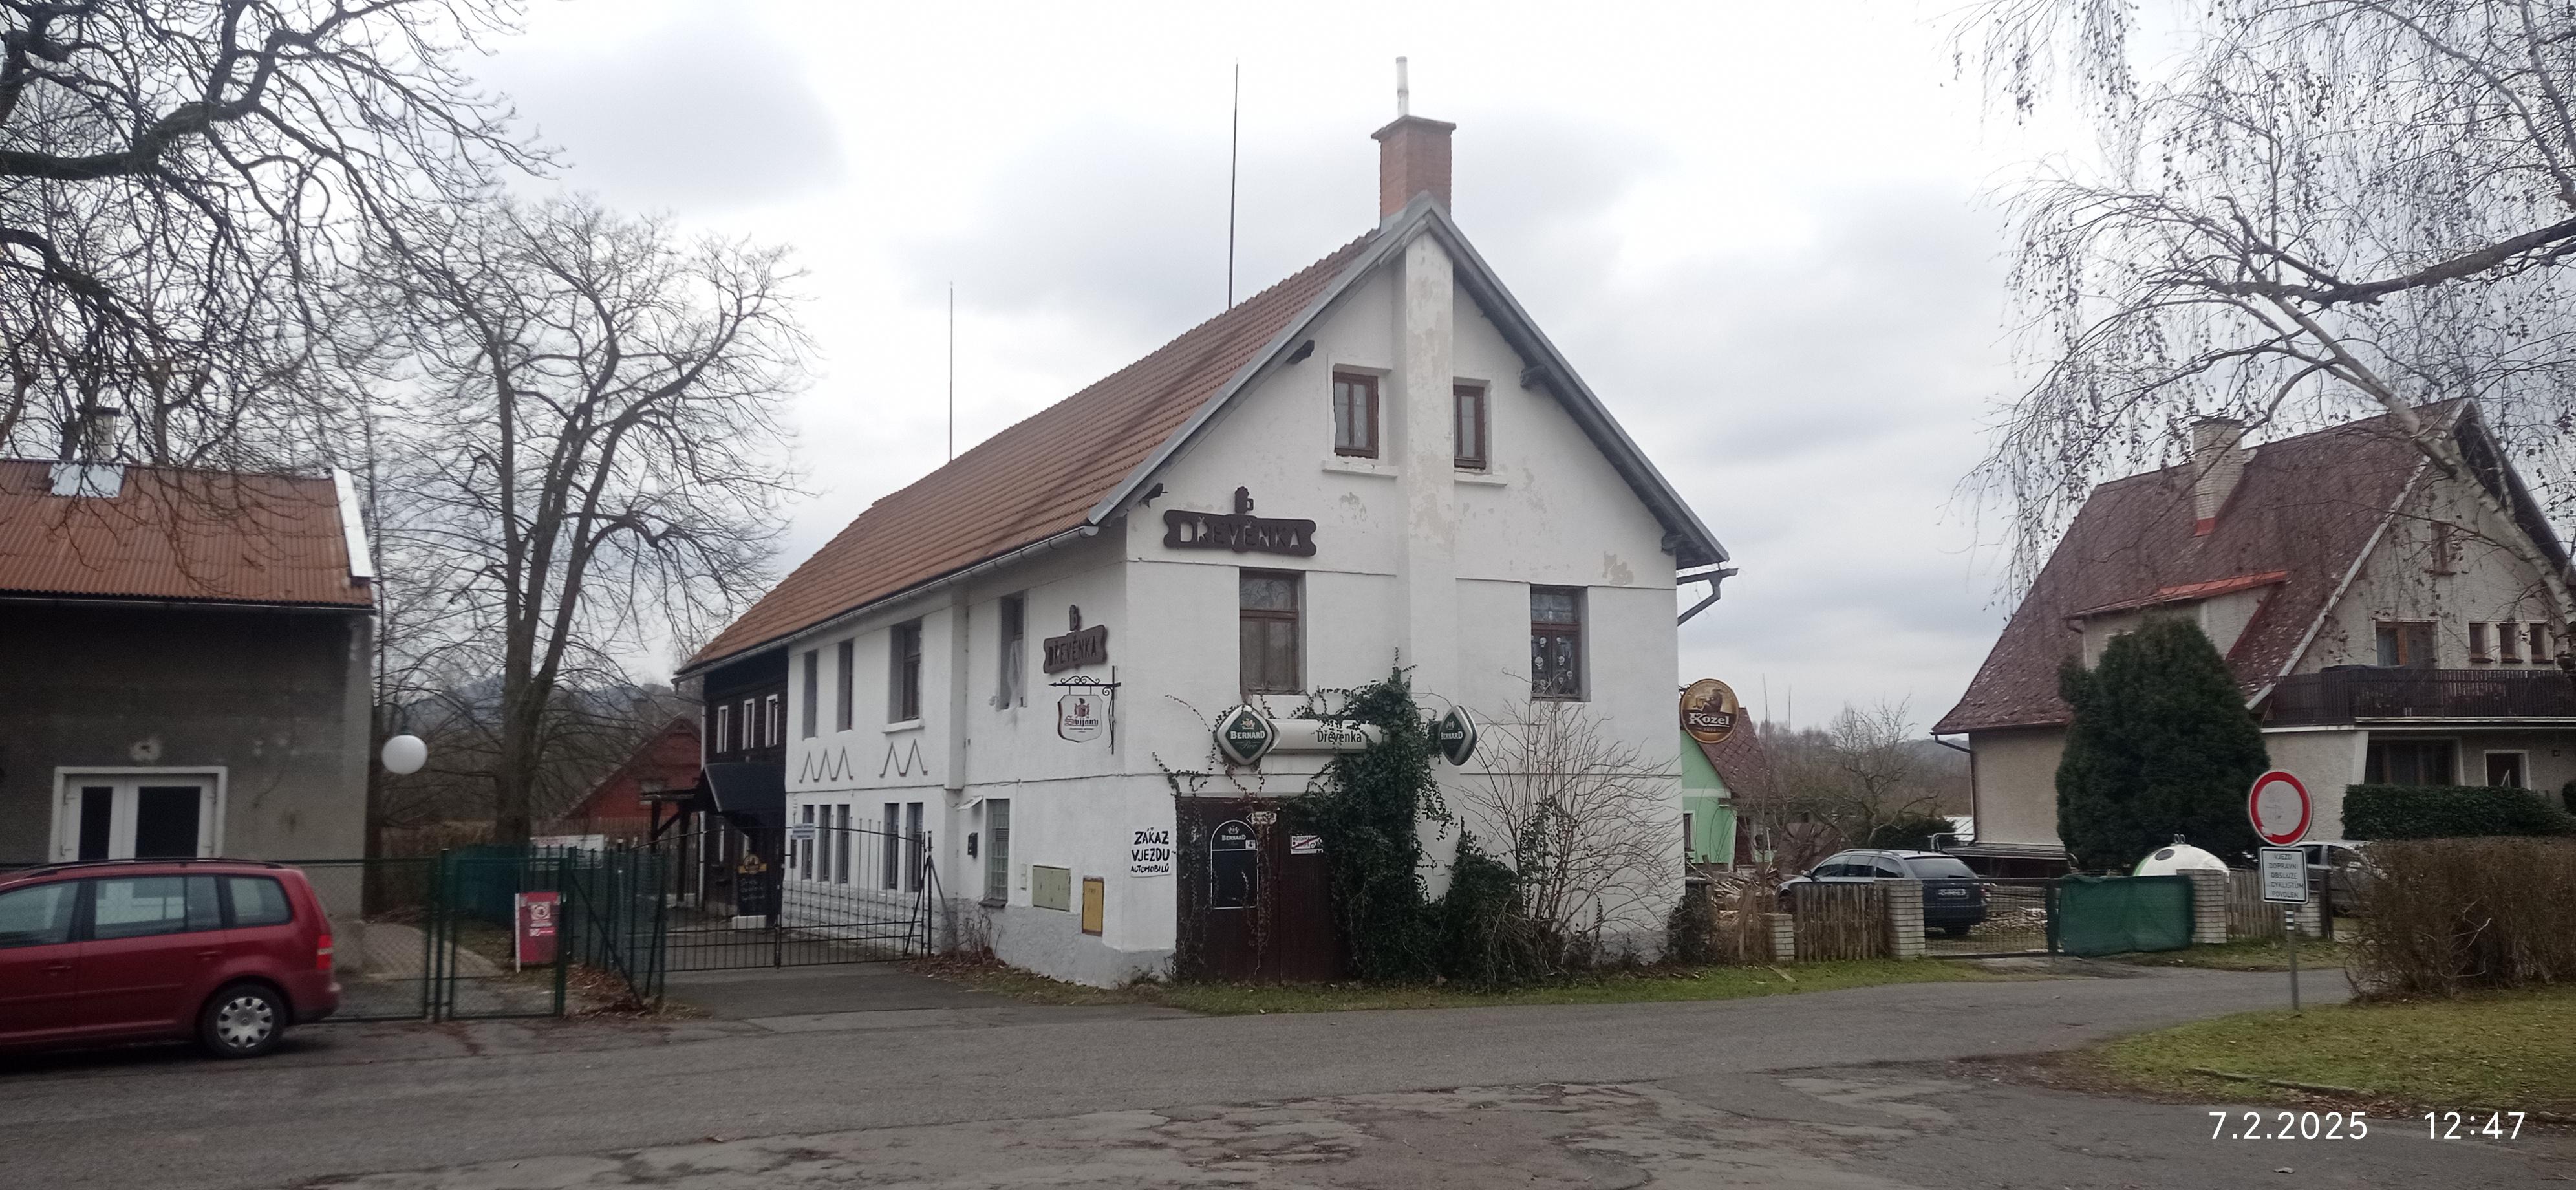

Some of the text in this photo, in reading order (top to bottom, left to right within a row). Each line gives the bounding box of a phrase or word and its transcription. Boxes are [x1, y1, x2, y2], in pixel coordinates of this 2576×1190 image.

[1179, 517, 1302, 548] DŘEVĚNKA
[1048, 635, 1097, 666] DŘEVĚNKA
[1064, 715, 1099, 726] Svijany
[1689, 713, 1730, 727] Kozel
[1230, 731, 1265, 739] BERNARD
[1441, 731, 1463, 740] BERNARD
[1134, 827, 1169, 845] ZÁKAZ
[1132, 848, 1170, 861] VJEZDU
